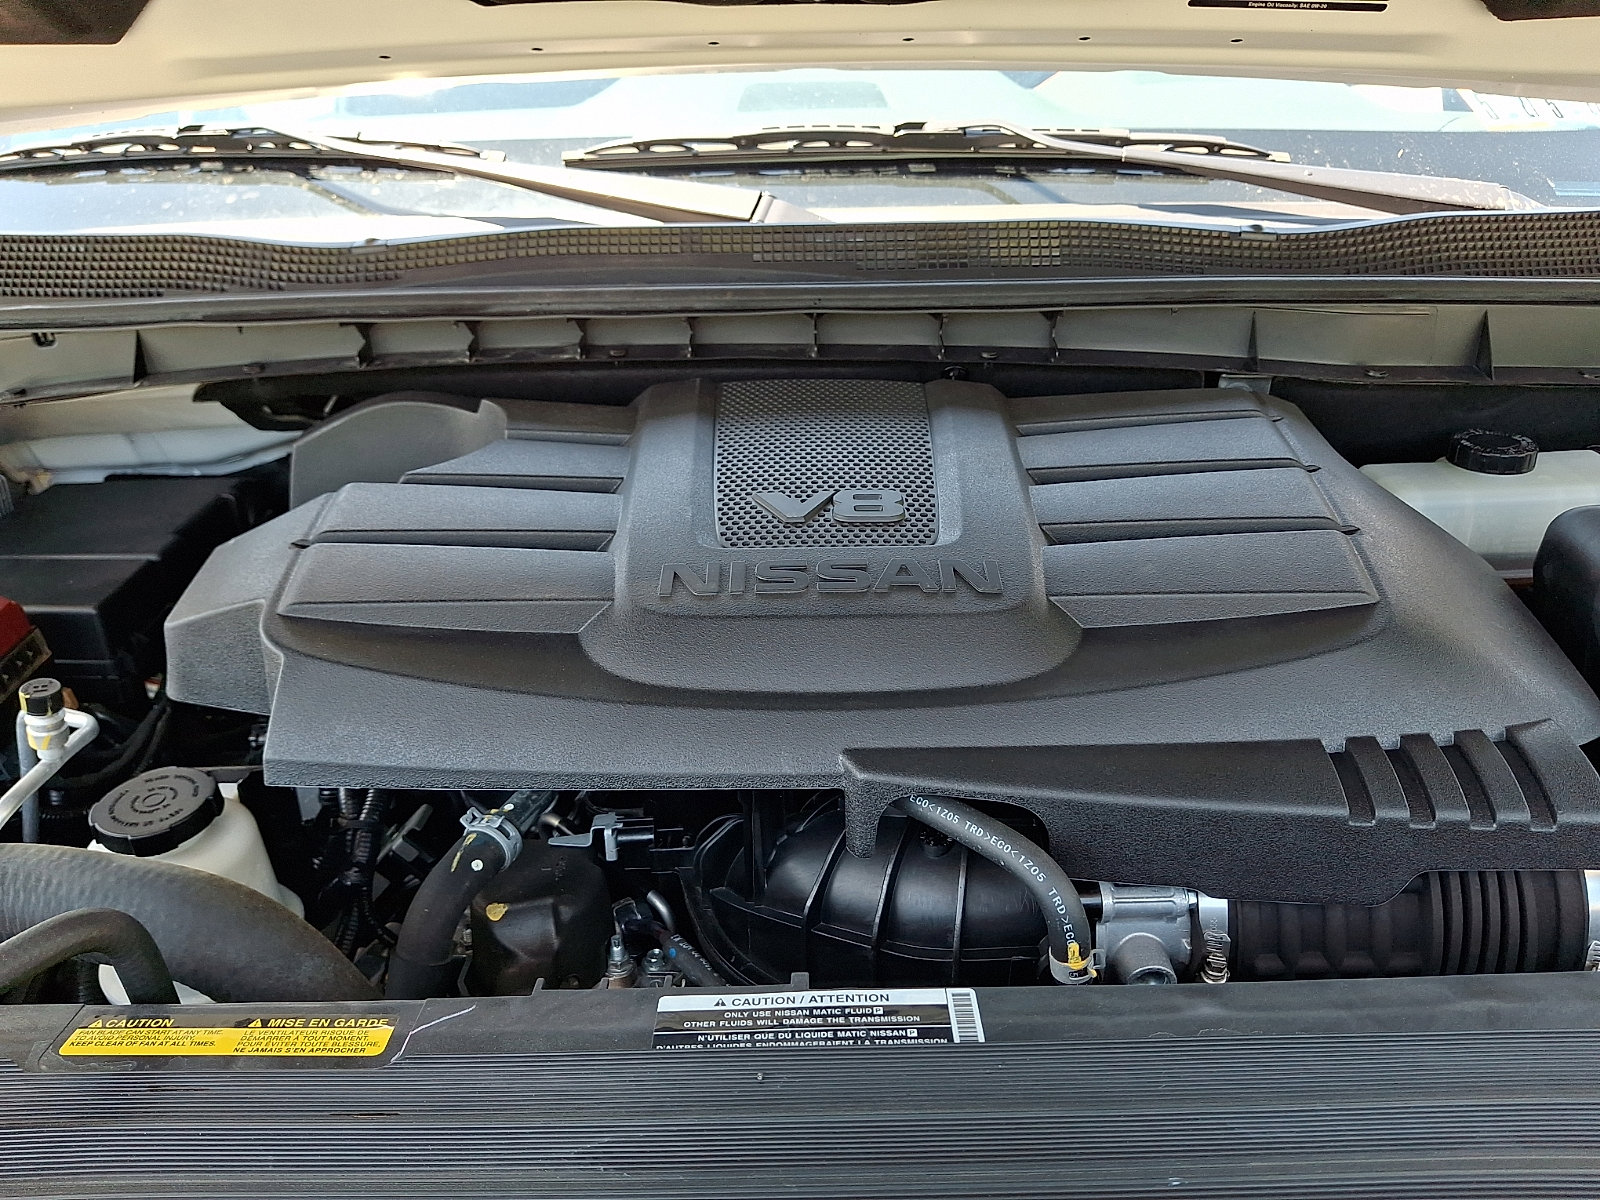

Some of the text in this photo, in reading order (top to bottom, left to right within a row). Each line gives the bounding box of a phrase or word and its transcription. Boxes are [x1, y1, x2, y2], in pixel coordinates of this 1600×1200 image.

[752, 489, 906, 525] V8
[659, 557, 1003, 597] NISSAN
[731, 996, 795, 1007] CAUTION
[808, 993, 890, 1004] ATTENTION
[813, 1008, 842, 1016] MATIC
[105, 1018, 175, 1027] CAUTION
[267, 1018, 389, 1028] MISE EN GARDE
[782, 1017, 824, 1025] DAMAGE
[826, 1016, 845, 1024] THE
[849, 1015, 921, 1024] TRANSMISSION
[697, 1033, 751, 1041] N'UTILISER
[795, 1030, 834, 1038] LIQUIDE
[837, 1030, 867, 1038] MATIC
[869, 1029, 906, 1037] NISSAN
